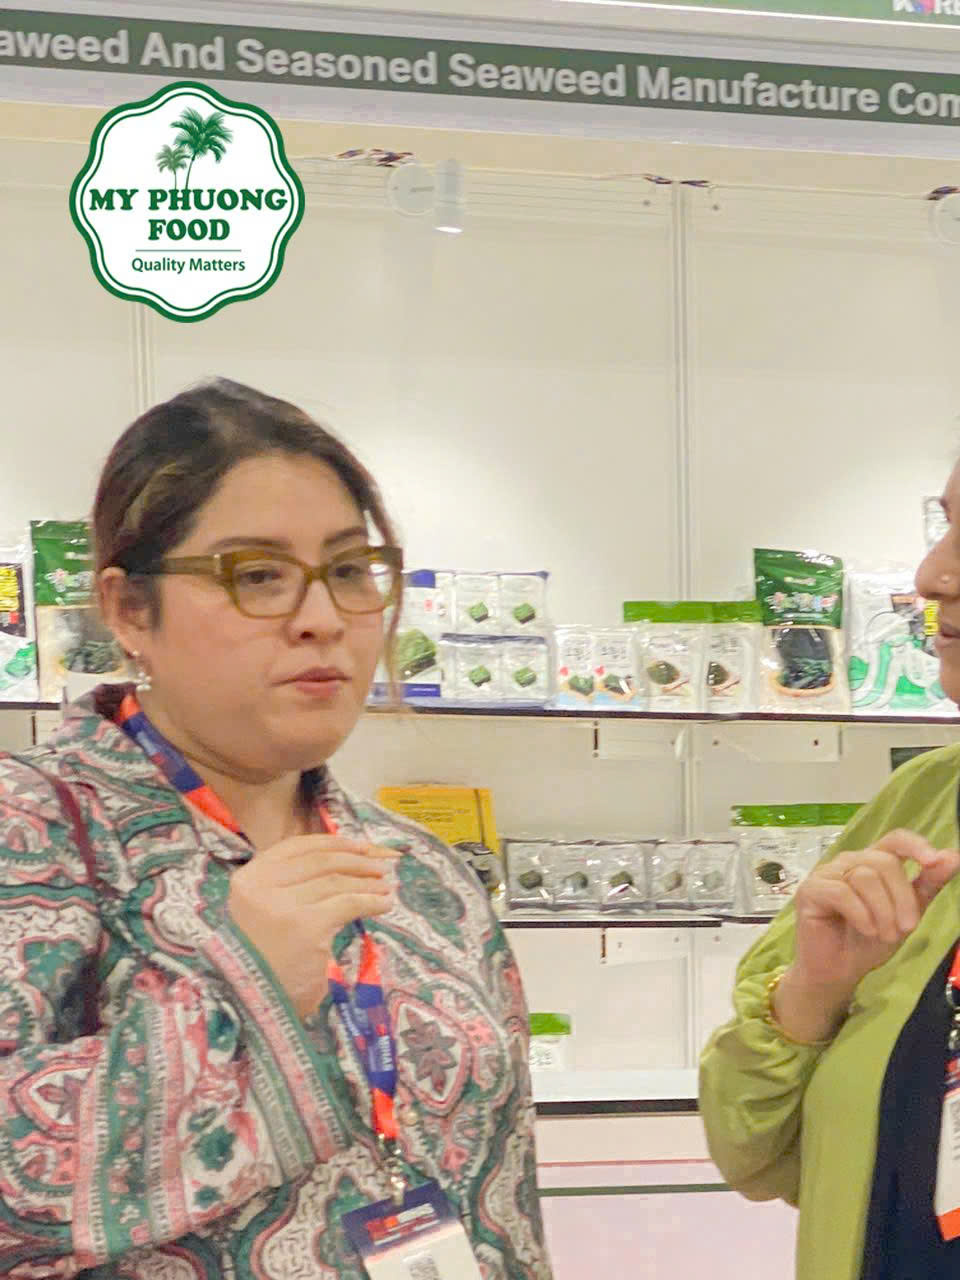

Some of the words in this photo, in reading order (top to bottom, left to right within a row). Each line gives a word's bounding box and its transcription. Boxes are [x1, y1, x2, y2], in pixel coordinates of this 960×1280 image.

[139, 31, 225, 71] And
[235, 39, 438, 86] Seasoned
[447, 53, 627, 99] Seaweed
[637, 65, 880, 114] Manufacture
